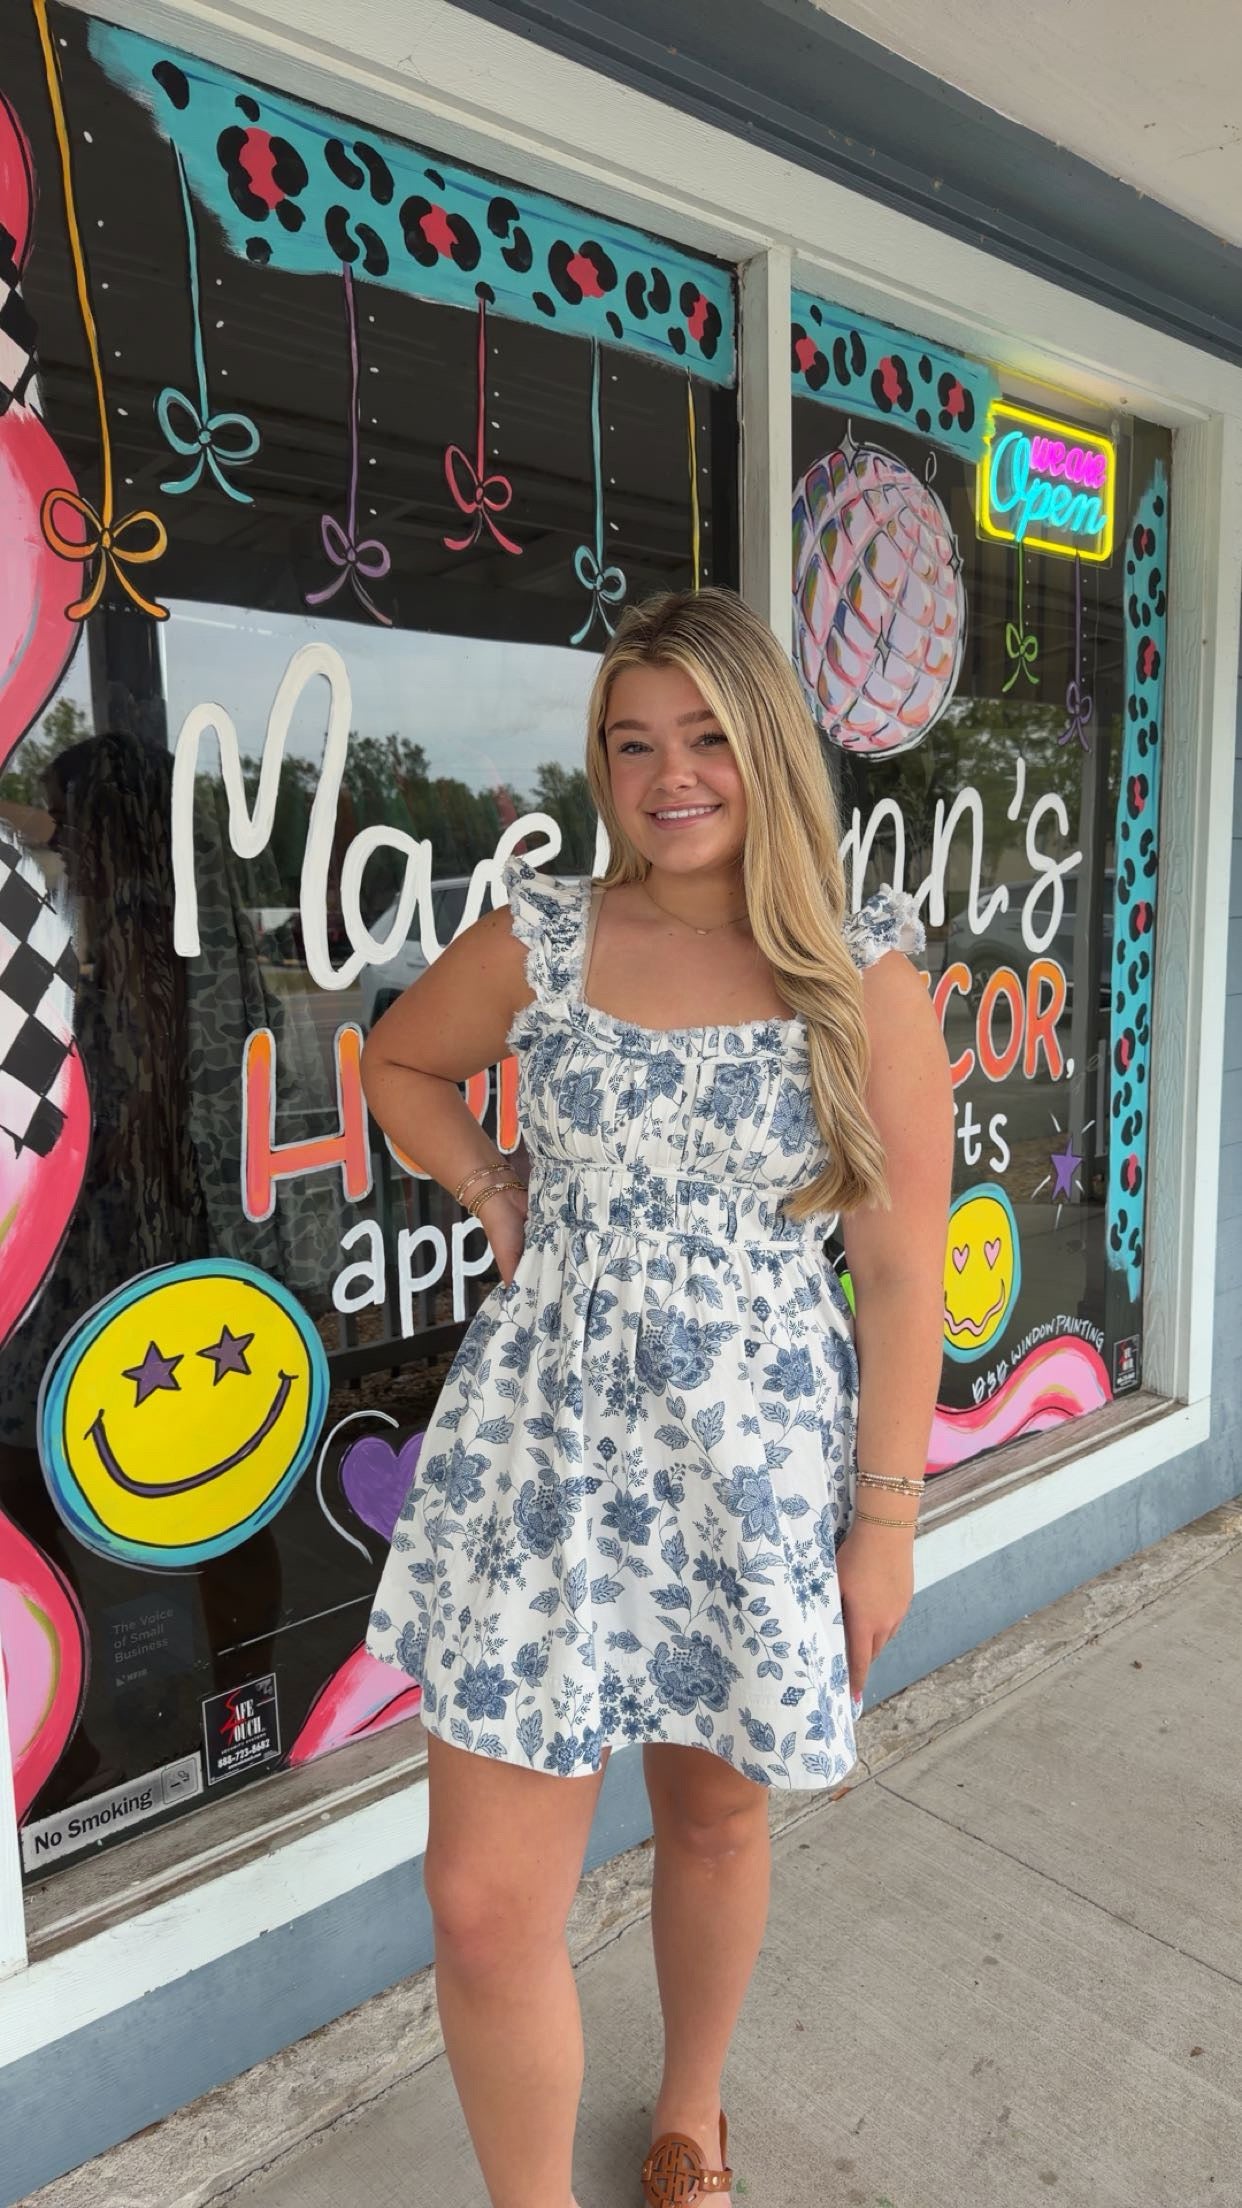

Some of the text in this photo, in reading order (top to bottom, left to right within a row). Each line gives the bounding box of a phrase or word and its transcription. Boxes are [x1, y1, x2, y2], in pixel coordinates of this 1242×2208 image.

[989, 430, 1109, 542] Open
[1011, 1318, 1056, 1365] WINDOW
[1055, 1315, 1105, 1352] PAINTING
[112, 1608, 174, 1635] The Voice
[113, 1623, 164, 1649] of Small
[114, 1638, 169, 1663] Business
[34, 1788, 153, 1854] No Smoking
